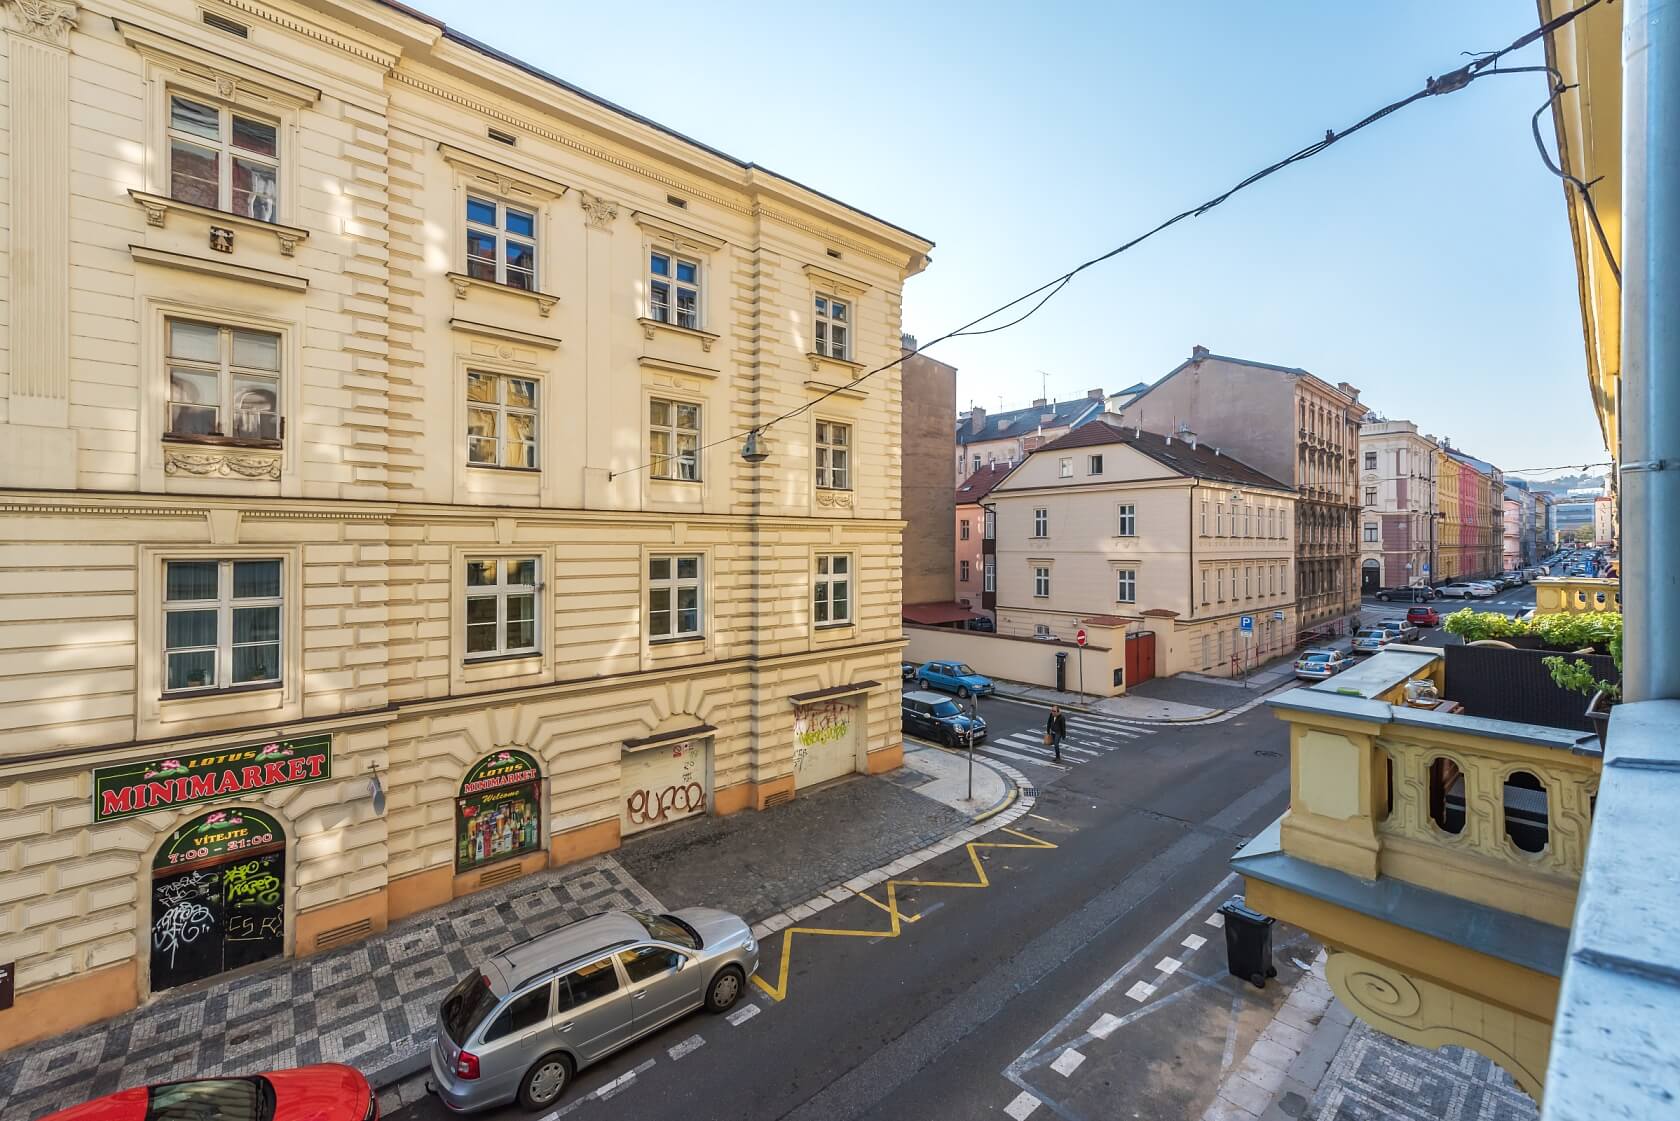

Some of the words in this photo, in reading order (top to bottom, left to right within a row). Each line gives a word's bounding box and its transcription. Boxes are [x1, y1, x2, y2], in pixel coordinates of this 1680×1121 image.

[1242, 617, 1251, 627] P
[187, 750, 257, 769] LOTUS
[479, 763, 523, 778] LOTUS
[101, 753, 326, 816] MINIMARKET
[464, 768, 537, 794] MINIMARKET
[481, 790, 520, 803] Welcome
[192, 828, 249, 846] VÍTEJTE
[168, 846, 209, 864] 7:00
[227, 833, 273, 851] 21:00
